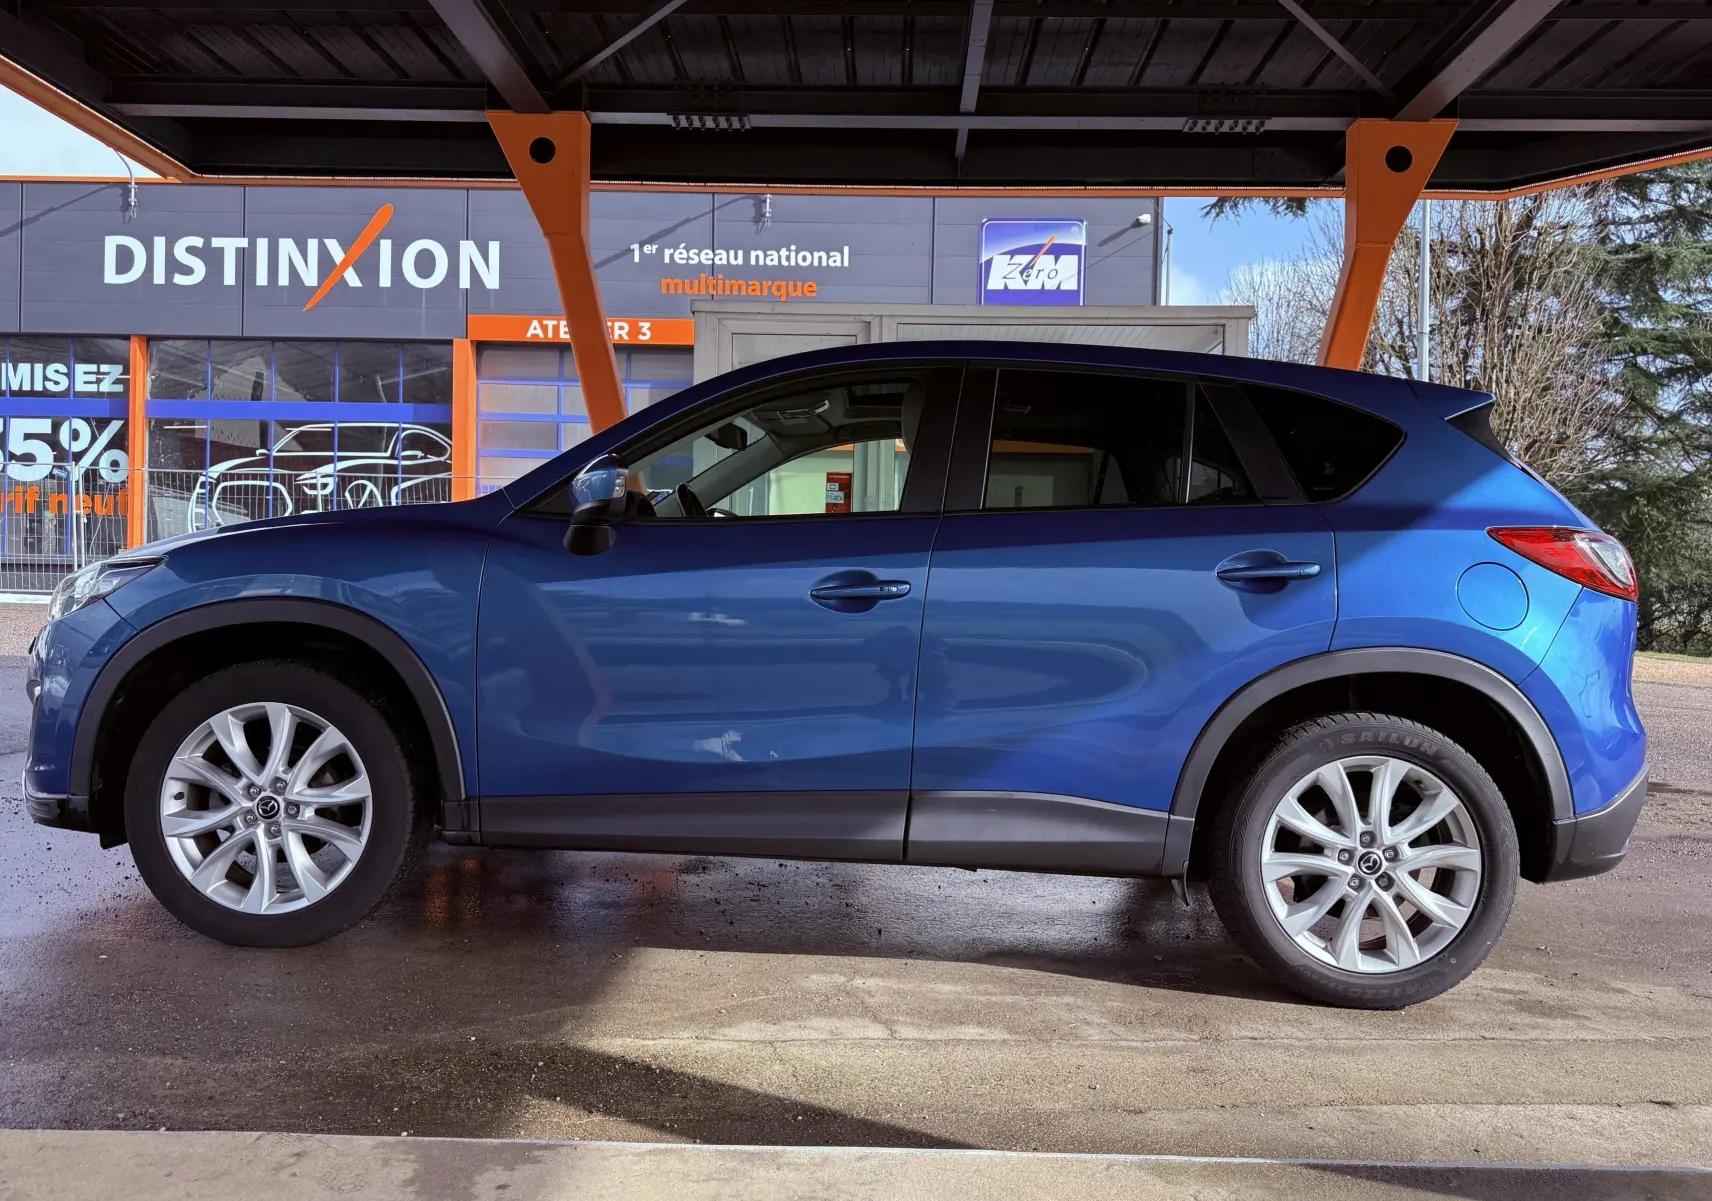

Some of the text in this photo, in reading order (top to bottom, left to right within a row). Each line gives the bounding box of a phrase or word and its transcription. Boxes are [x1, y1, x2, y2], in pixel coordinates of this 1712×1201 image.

[103, 203, 500, 311] DISTINXION
[663, 243, 744, 265] réseau
[750, 245, 850, 267] national
[660, 273, 818, 302] multimarque
[638, 321, 652, 341] 3
[1340, 731, 1438, 756] SAILUN
